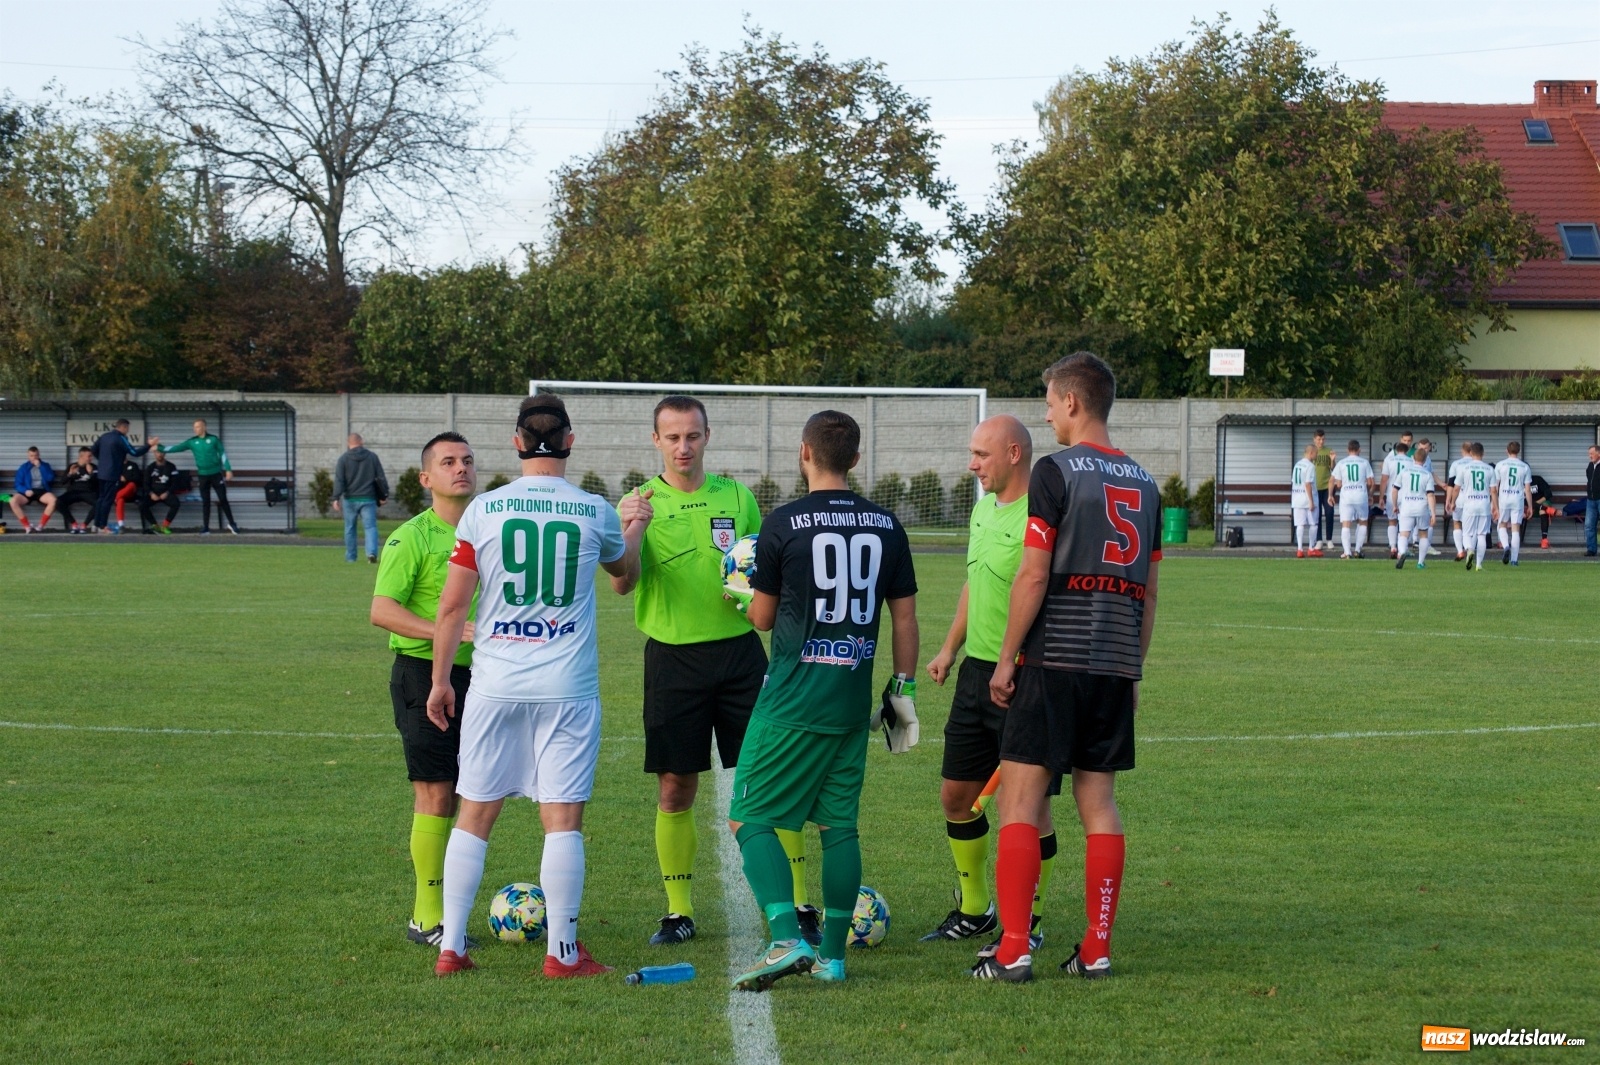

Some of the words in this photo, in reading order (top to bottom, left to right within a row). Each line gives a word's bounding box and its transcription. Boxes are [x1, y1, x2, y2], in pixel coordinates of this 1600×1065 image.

[69, 434, 142, 444] TWOW
[1068, 457, 1095, 472] LKS
[1346, 464, 1359, 482] 10
[1295, 468, 1302, 484] 11
[1410, 473, 1420, 492] 11
[1471, 470, 1485, 491] 13
[1508, 467, 1517, 486] 5
[486, 500, 503, 514] LKS
[507, 499, 552, 514] POLONIA
[556, 501, 596, 519] ŁAZISKA
[680, 502, 707, 510] zina
[790, 513, 811, 530] LKS
[813, 512, 856, 527] POLONIA
[858, 512, 894, 530] ŁAZISKA
[1102, 482, 1141, 566] 5
[501, 518, 581, 608] 90
[812, 532, 883, 625] 99
[492, 616, 577, 640] moya
[802, 634, 875, 671] moya
[664, 873, 692, 881] zina
